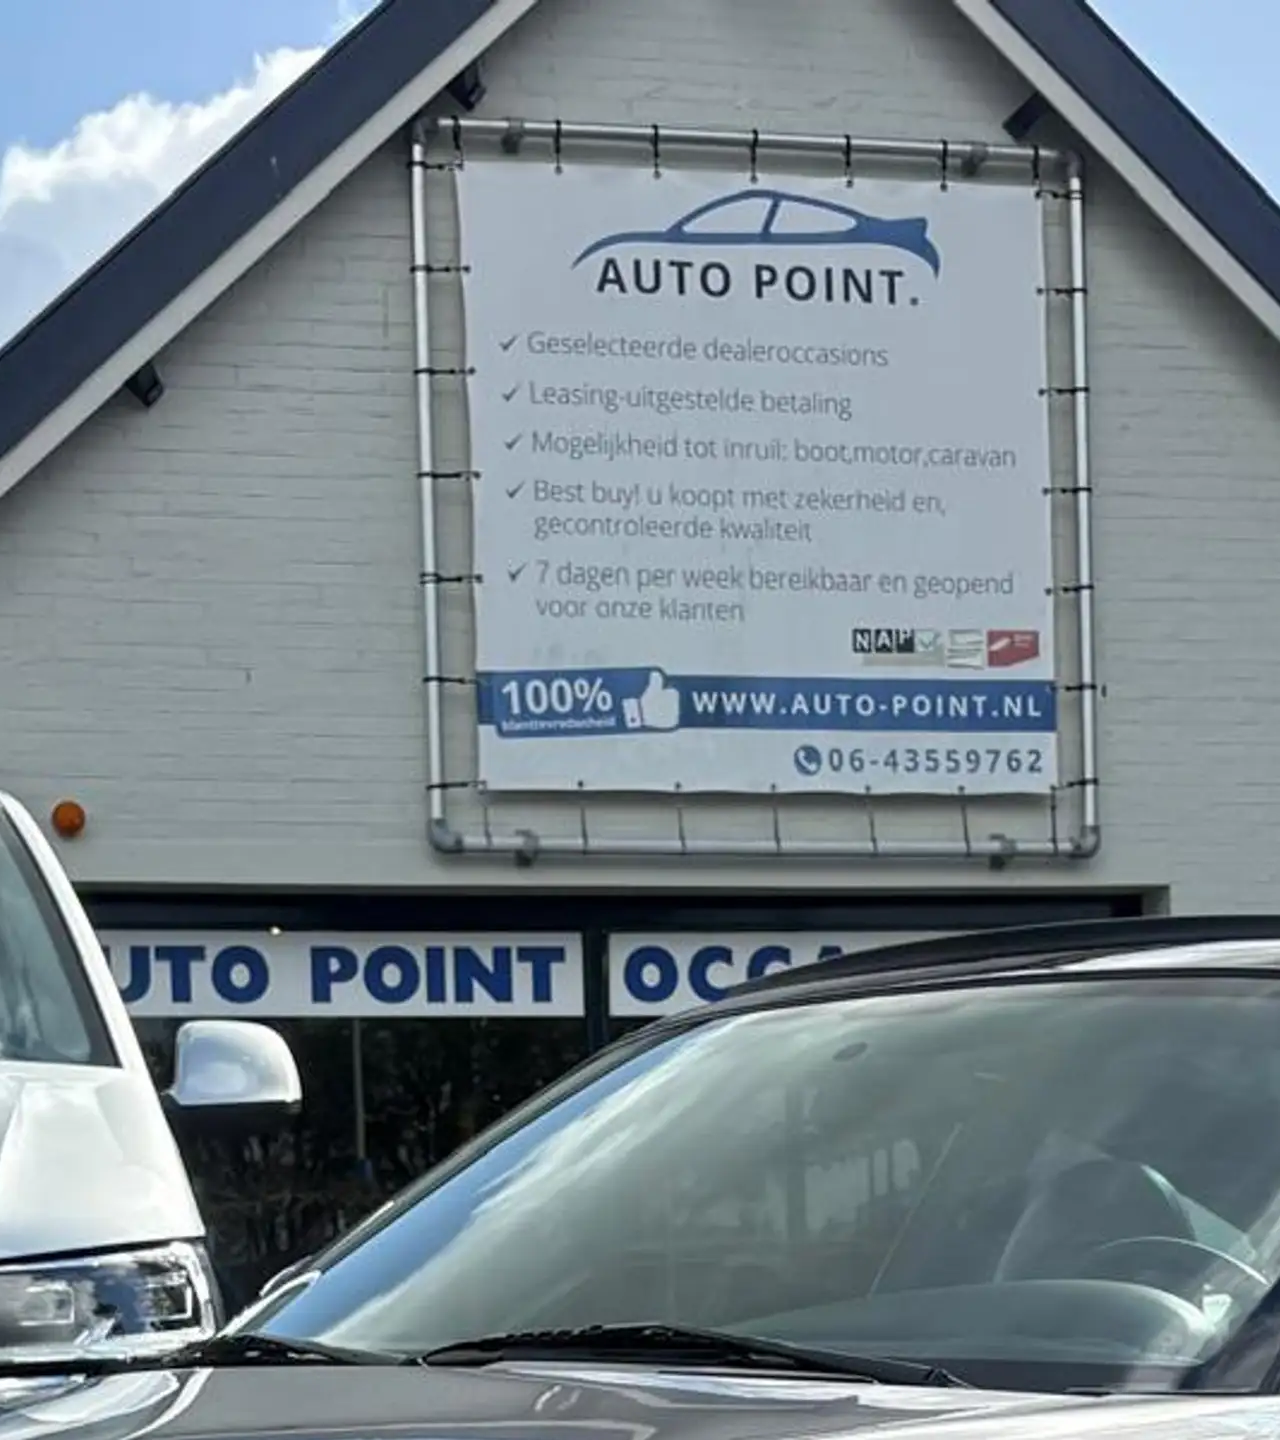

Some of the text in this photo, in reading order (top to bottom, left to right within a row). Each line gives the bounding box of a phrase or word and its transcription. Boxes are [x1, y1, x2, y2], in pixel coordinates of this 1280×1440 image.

[596, 257, 732, 298] AUTO
[526, 330, 889, 367] Geselecteerde dealeroccasions
[528, 380, 853, 421] Leasing-uitgestelde betaling
[531, 431, 678, 461] Mogelijkheid
[684, 439, 718, 459] tot
[533, 480, 584, 503] Best
[646, 487, 663, 506] u
[670, 482, 734, 513] koopt
[742, 489, 788, 510] met
[795, 488, 907, 512] zekerheid
[533, 515, 812, 543] gecontroleerde kwaliteit
[535, 559, 1015, 600] 7 dagen per week bereikbaar en geopend
[535, 597, 746, 622] voor onze klanten
[501, 677, 613, 715] 100%
[691, 691, 1043, 718] WWW.AUTO-POINT.NL
[828, 748, 1043, 774] 06-43559762
[103, 945, 566, 1003] UTO POINT
